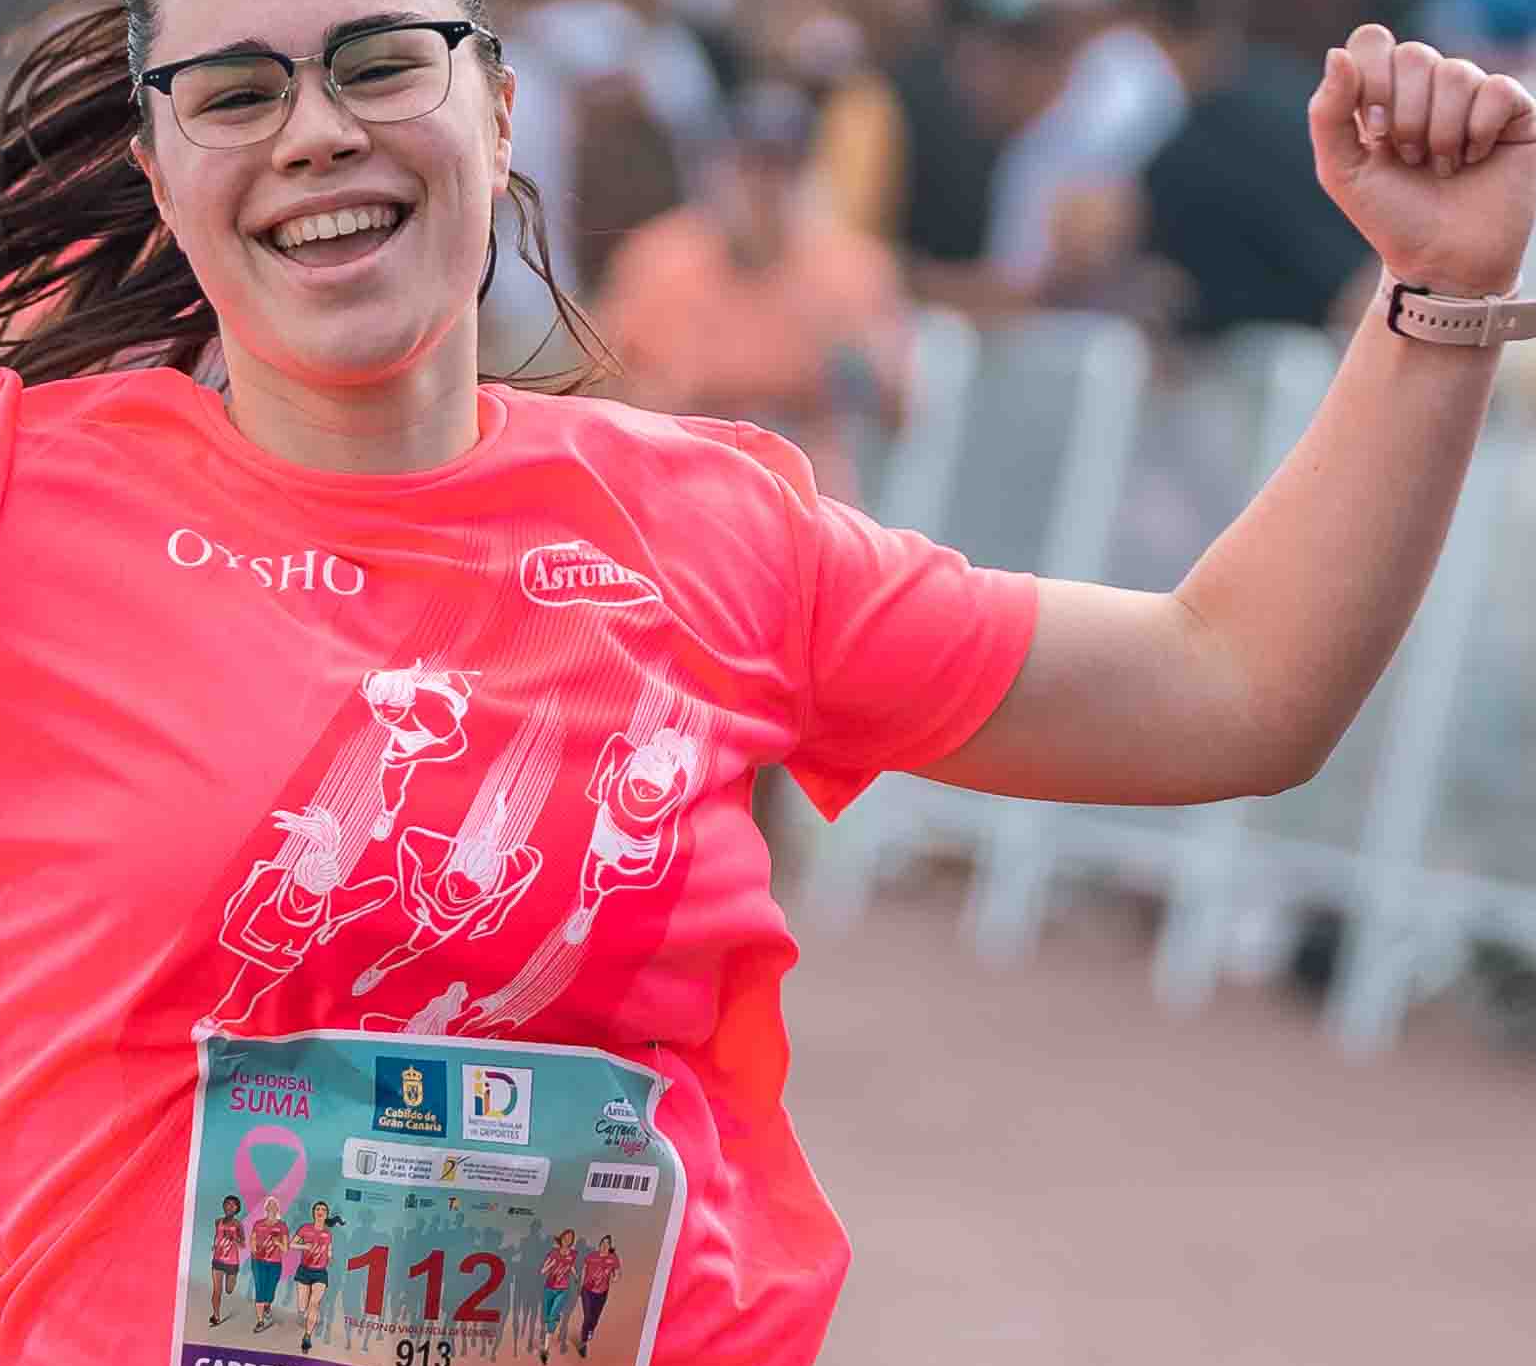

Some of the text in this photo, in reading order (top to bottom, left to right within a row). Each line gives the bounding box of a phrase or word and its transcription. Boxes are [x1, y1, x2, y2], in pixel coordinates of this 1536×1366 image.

[167, 528, 366, 596] OYSHO
[230, 1087, 310, 1120] SUMA
[378, 1116, 442, 1132] Gran Canaria
[347, 1245, 507, 1322] 112
